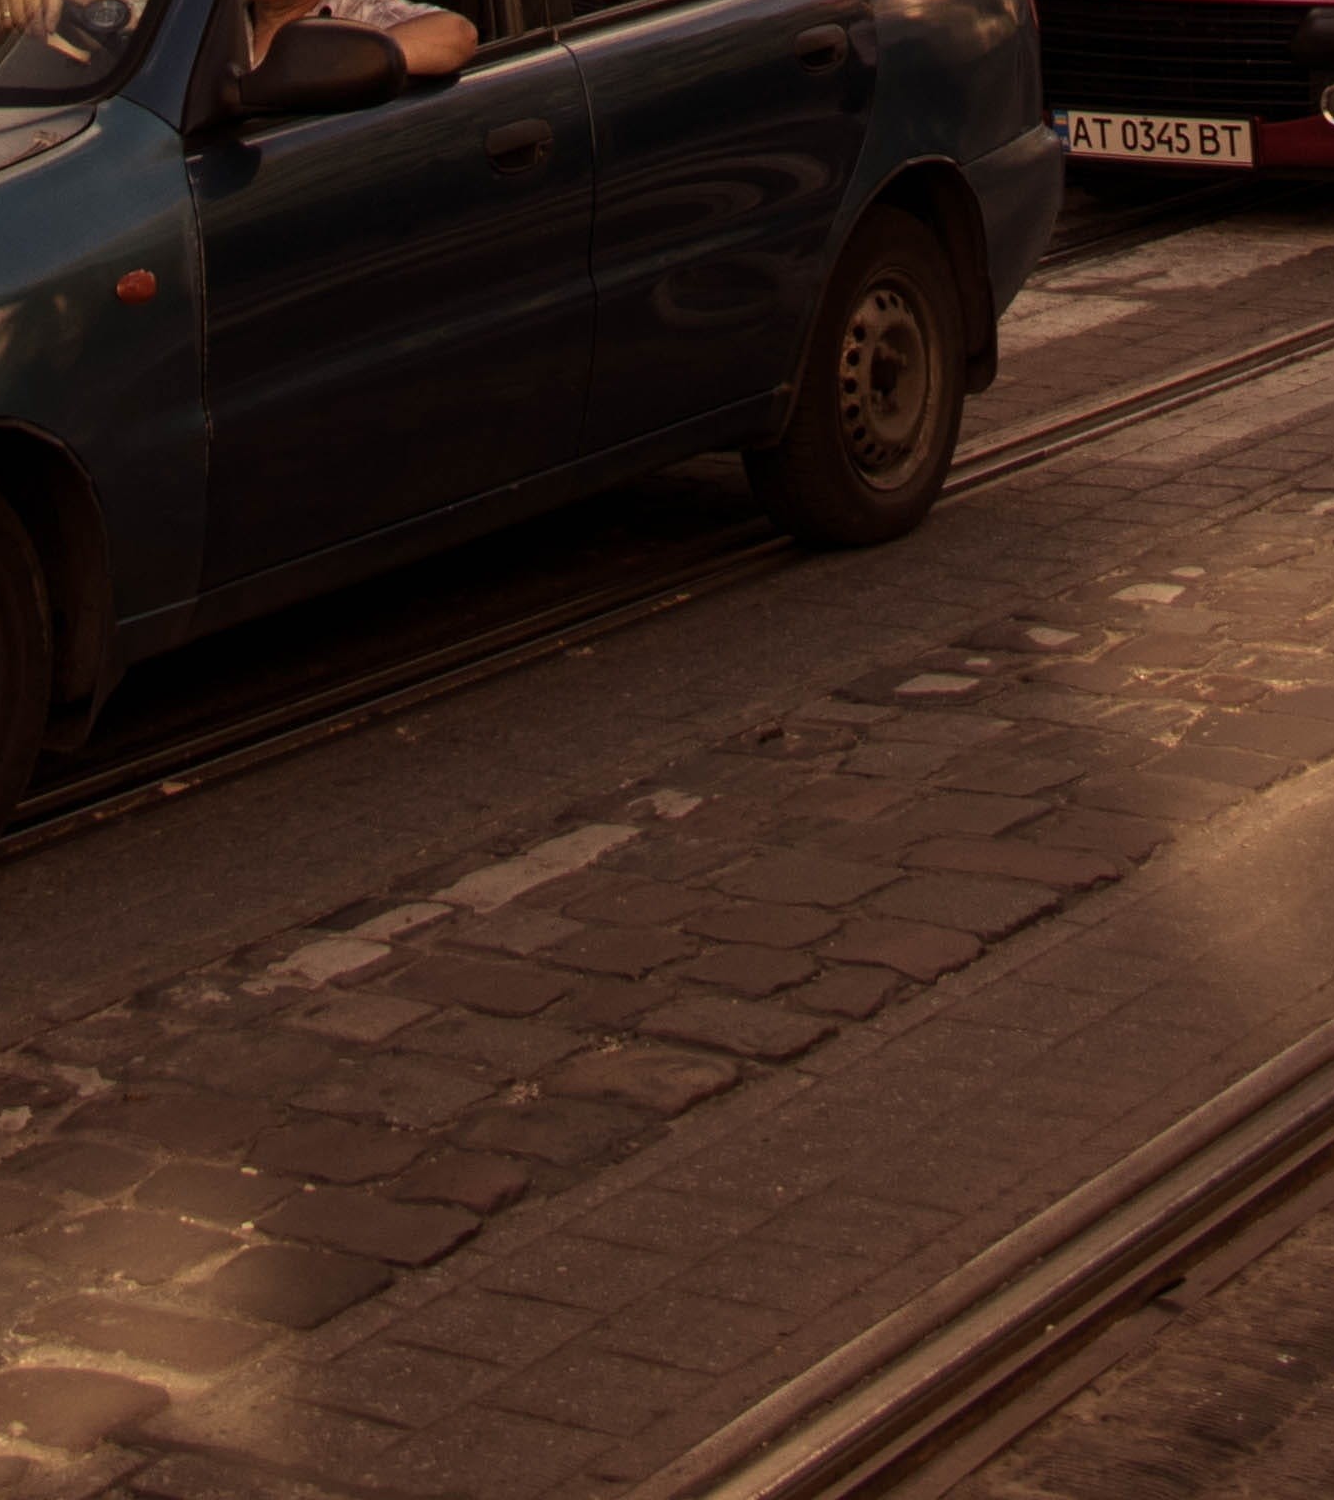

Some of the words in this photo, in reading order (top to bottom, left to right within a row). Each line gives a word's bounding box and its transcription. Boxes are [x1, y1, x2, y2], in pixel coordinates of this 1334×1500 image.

[1073, 117, 1112, 149] AT
[1121, 120, 1190, 153] 0345
[1199, 124, 1242, 156] BT
